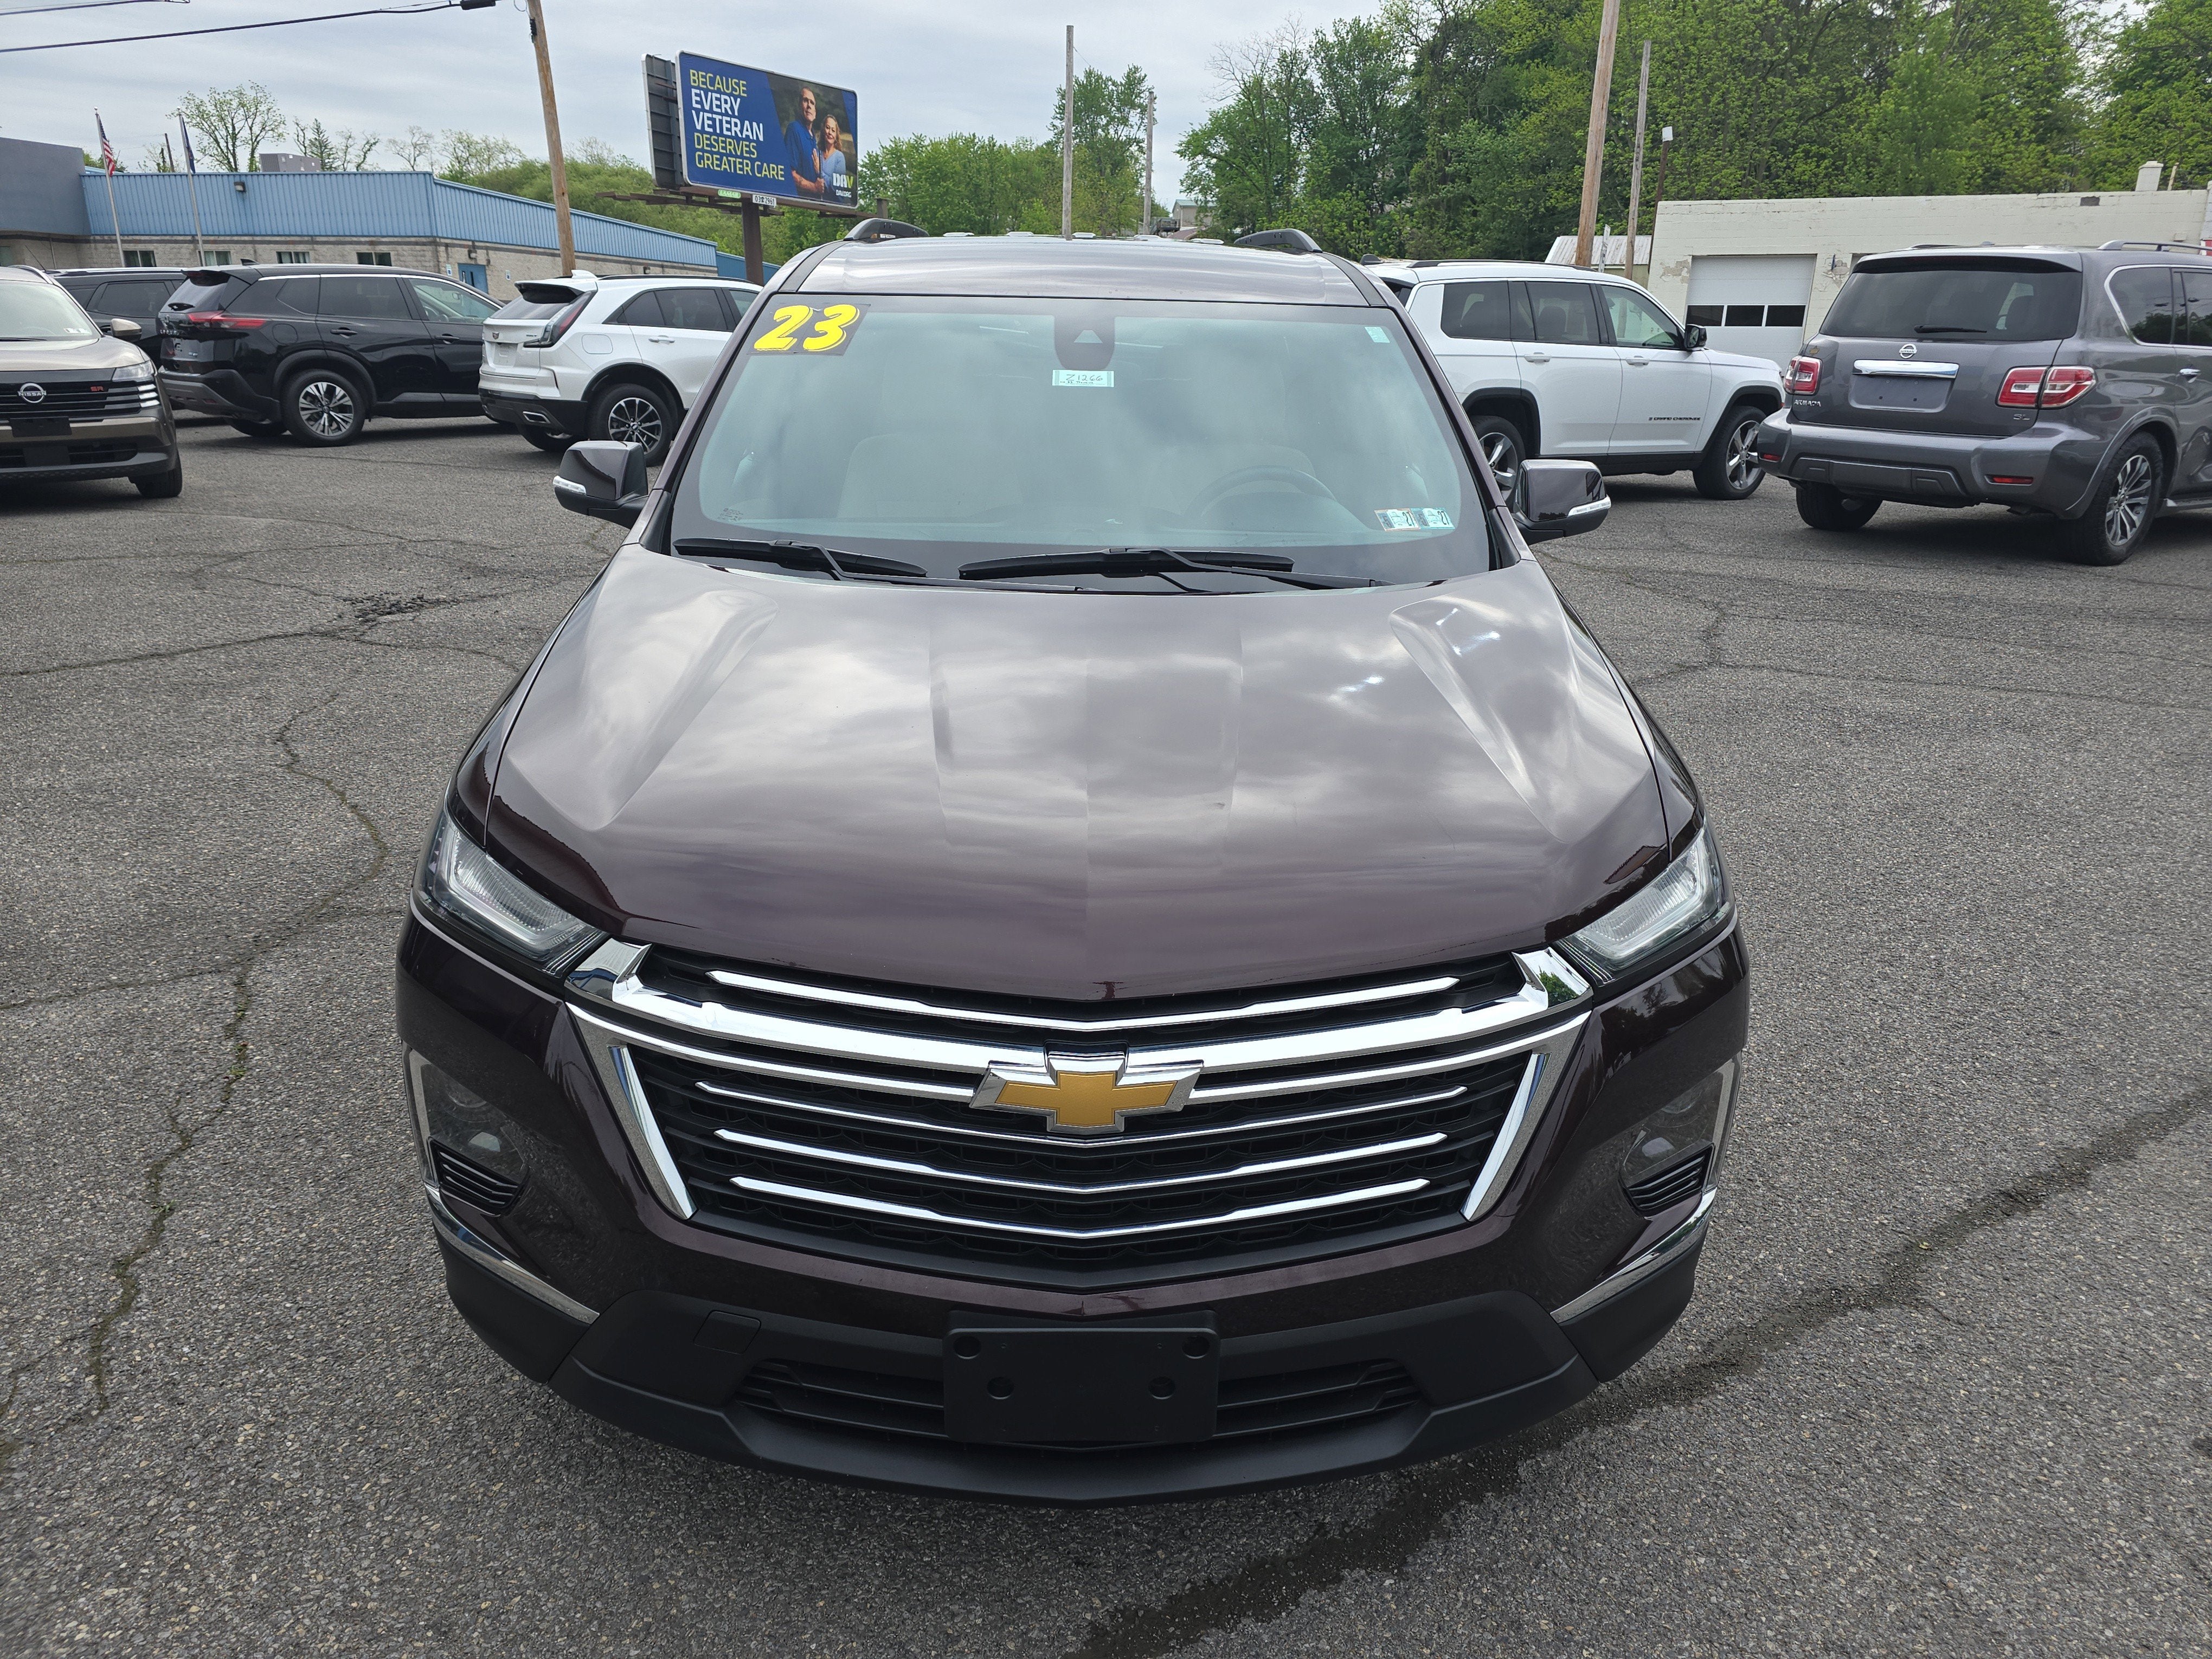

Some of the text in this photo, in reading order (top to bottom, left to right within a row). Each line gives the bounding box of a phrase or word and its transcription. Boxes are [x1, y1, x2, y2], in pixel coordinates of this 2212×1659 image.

[690, 69, 747, 97] BECAUSE
[691, 88, 741, 116] EVERY
[692, 110, 763, 141] VETERAN
[694, 132, 757, 158] DESERVES
[696, 151, 785, 181] GREATER CARE
[833, 172, 853, 189] DAV
[754, 304, 860, 351] 23
